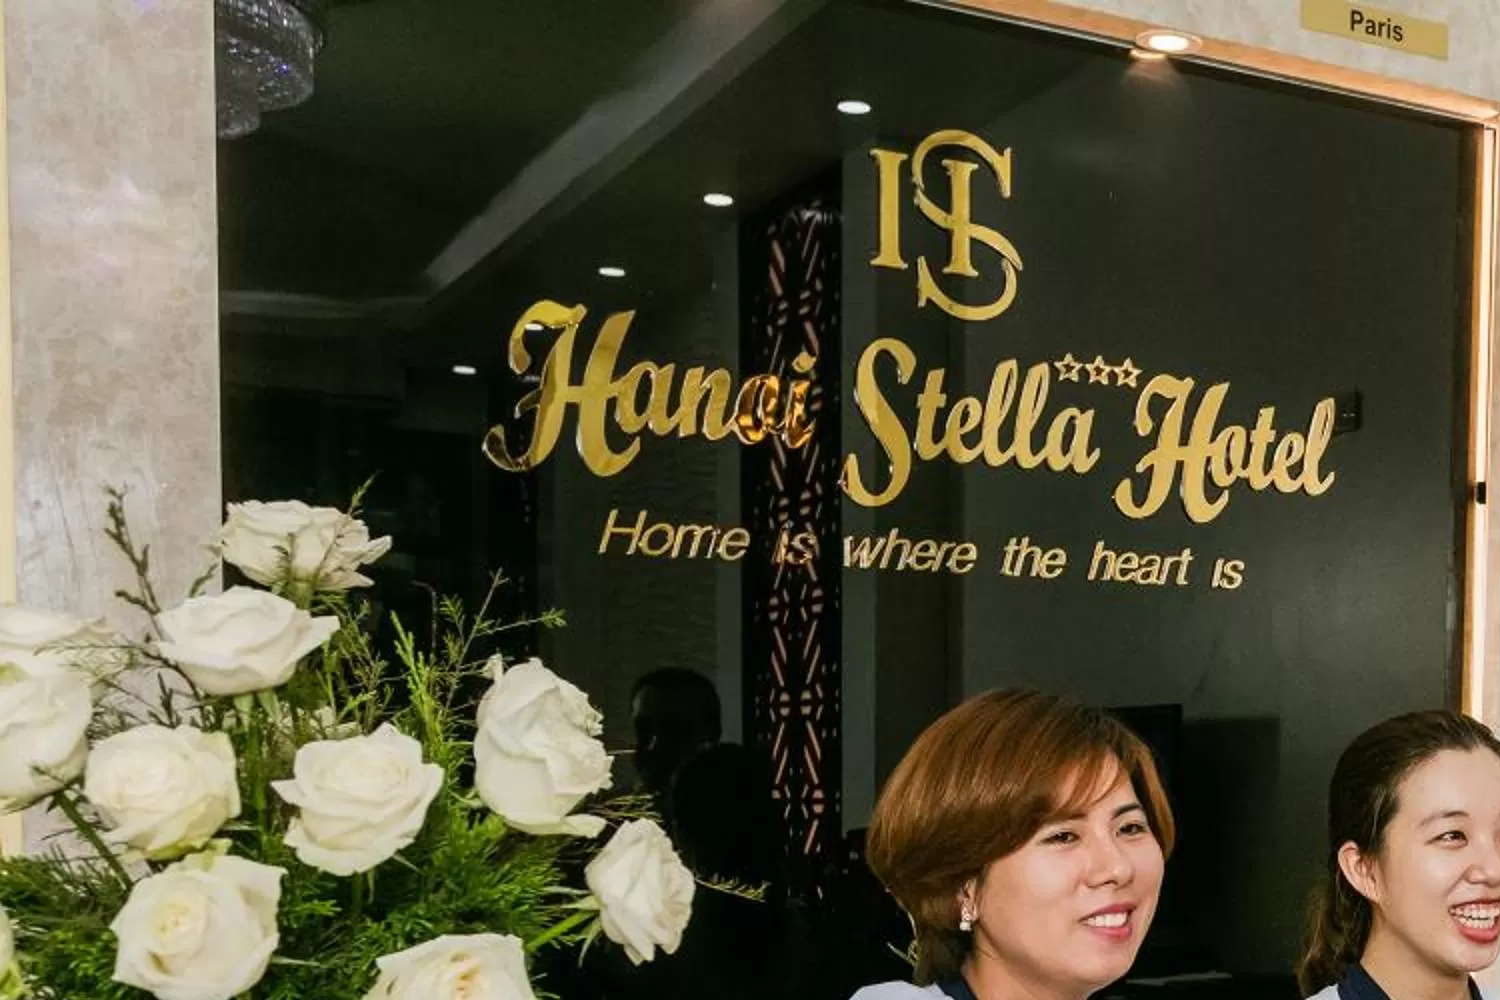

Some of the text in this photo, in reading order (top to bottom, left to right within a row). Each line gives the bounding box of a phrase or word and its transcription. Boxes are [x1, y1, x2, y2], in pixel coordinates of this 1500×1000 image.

[1350, 9, 1404, 42] Paris
[482, 300, 1336, 523] Hanoi Stella Hotel
[598, 508, 1245, 590] Home is where the heart is
